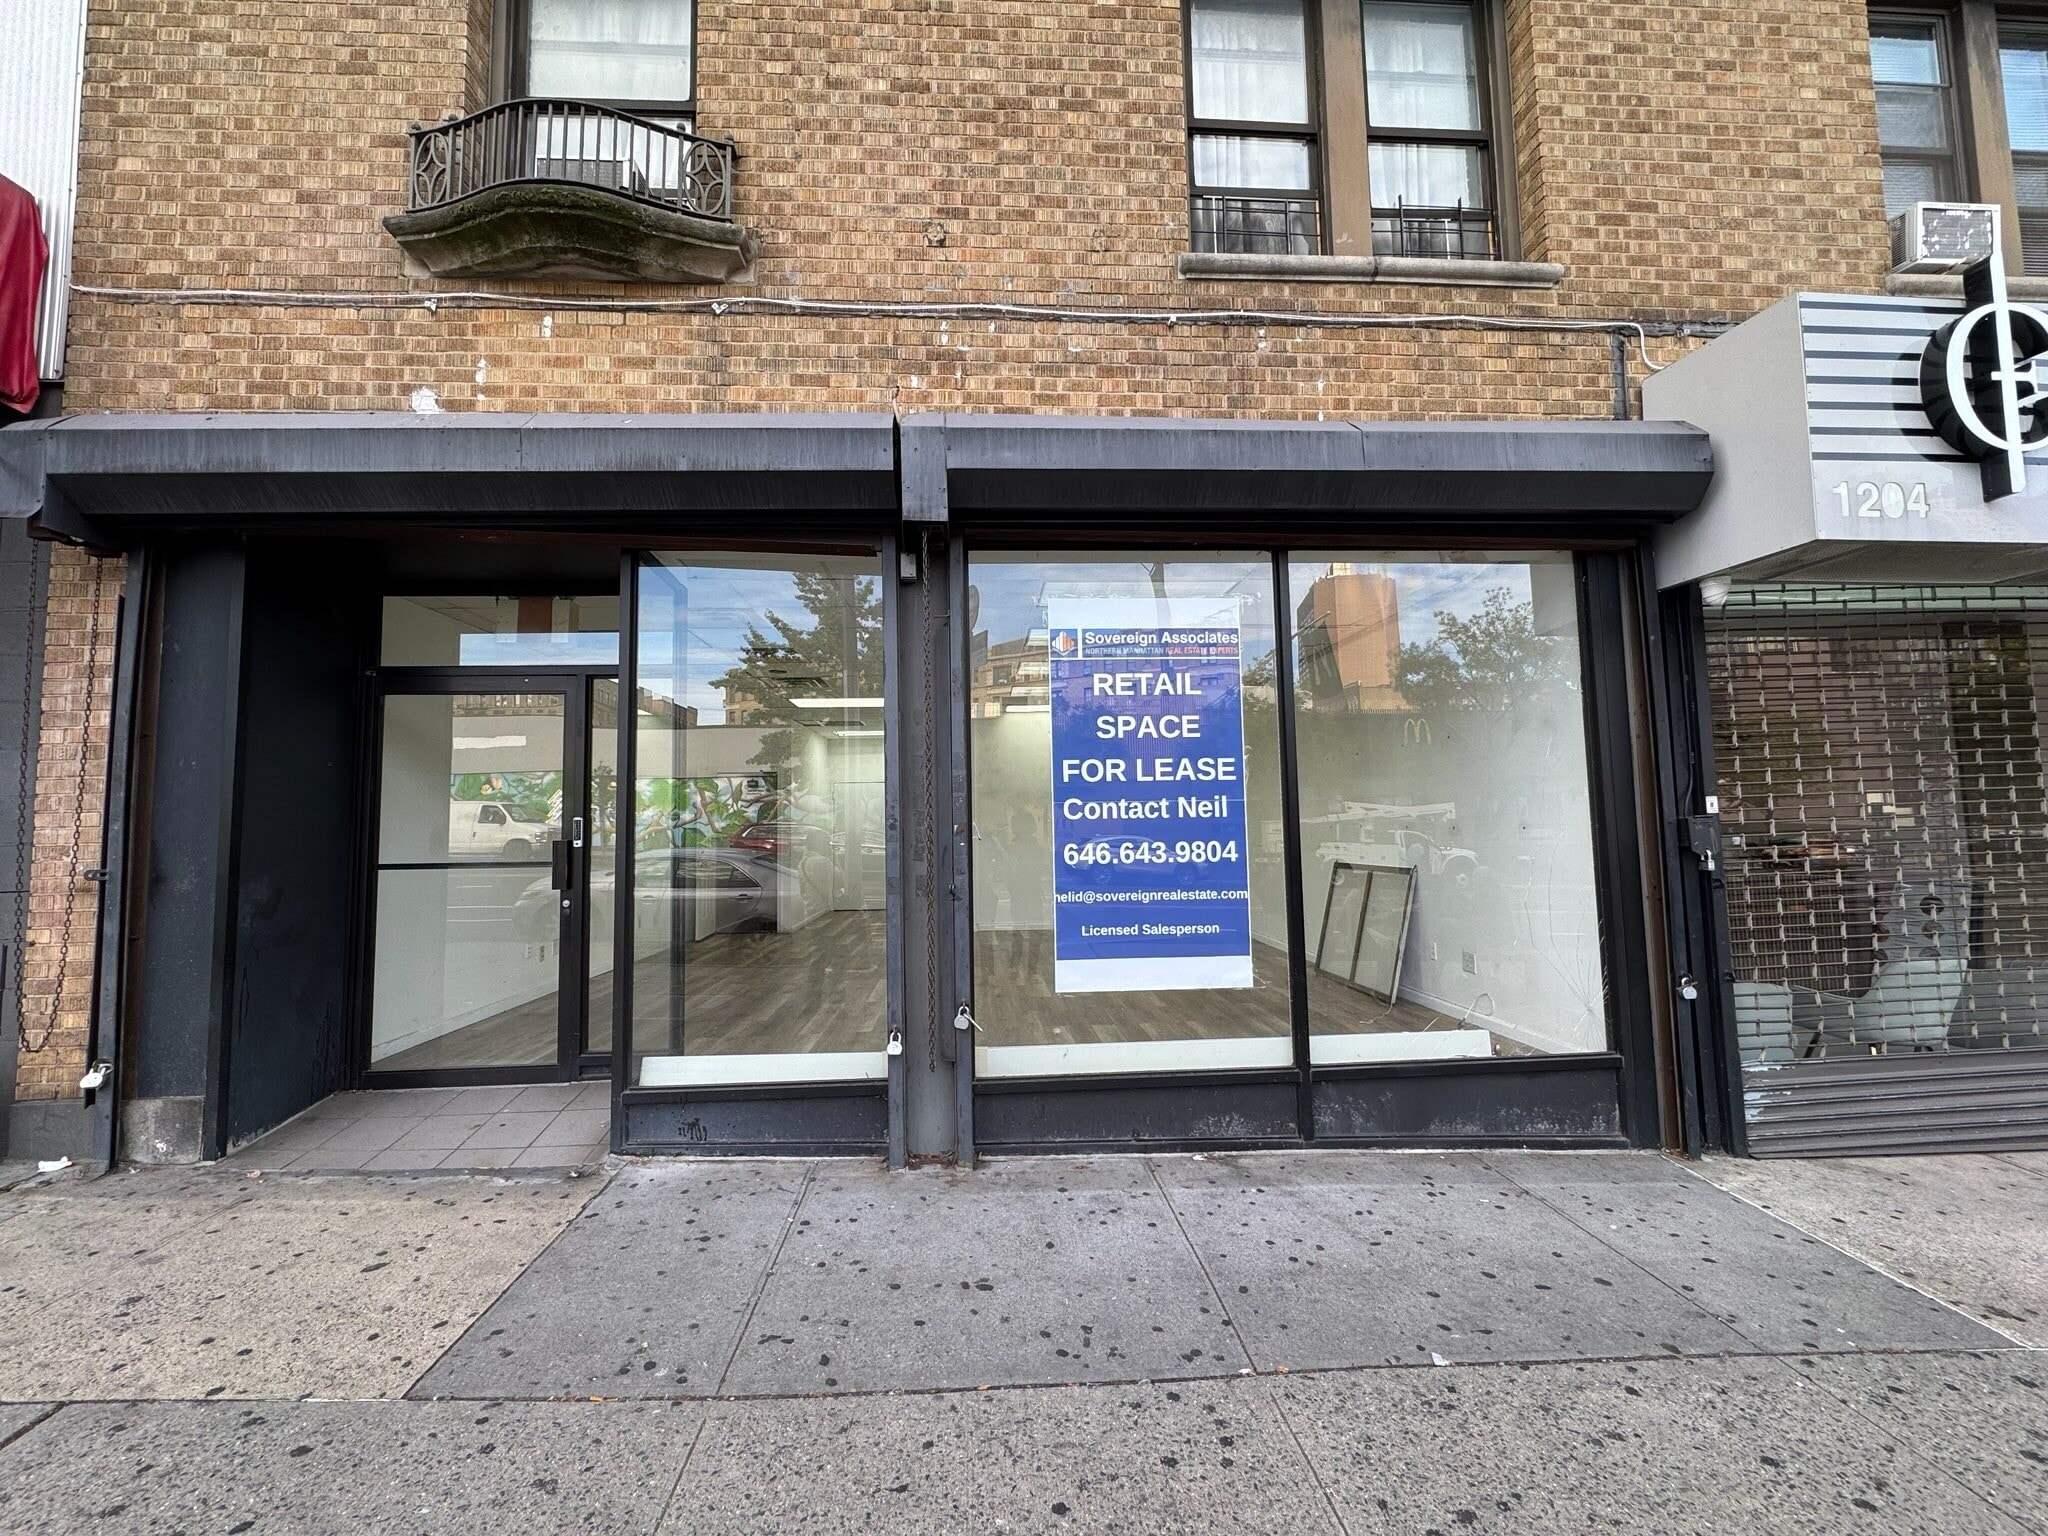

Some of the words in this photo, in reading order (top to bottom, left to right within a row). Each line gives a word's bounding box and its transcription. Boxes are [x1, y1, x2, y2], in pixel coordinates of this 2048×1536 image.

[1832, 480, 1931, 519] 1204
[1084, 631, 1157, 646] Sovereign
[1161, 630, 1238, 644] Associates
[1093, 672, 1202, 696] RETAIL
[1096, 715, 1201, 739] SPACE
[1063, 758, 1127, 783] FOR
[1136, 757, 1237, 782] LEASE
[1063, 797, 1170, 820] Contact
[1178, 795, 1228, 818] Neil
[1063, 840, 1238, 865] 646.643.9804
[1081, 924, 1139, 936] Licensed
[1142, 923, 1220, 936] Salesperson
